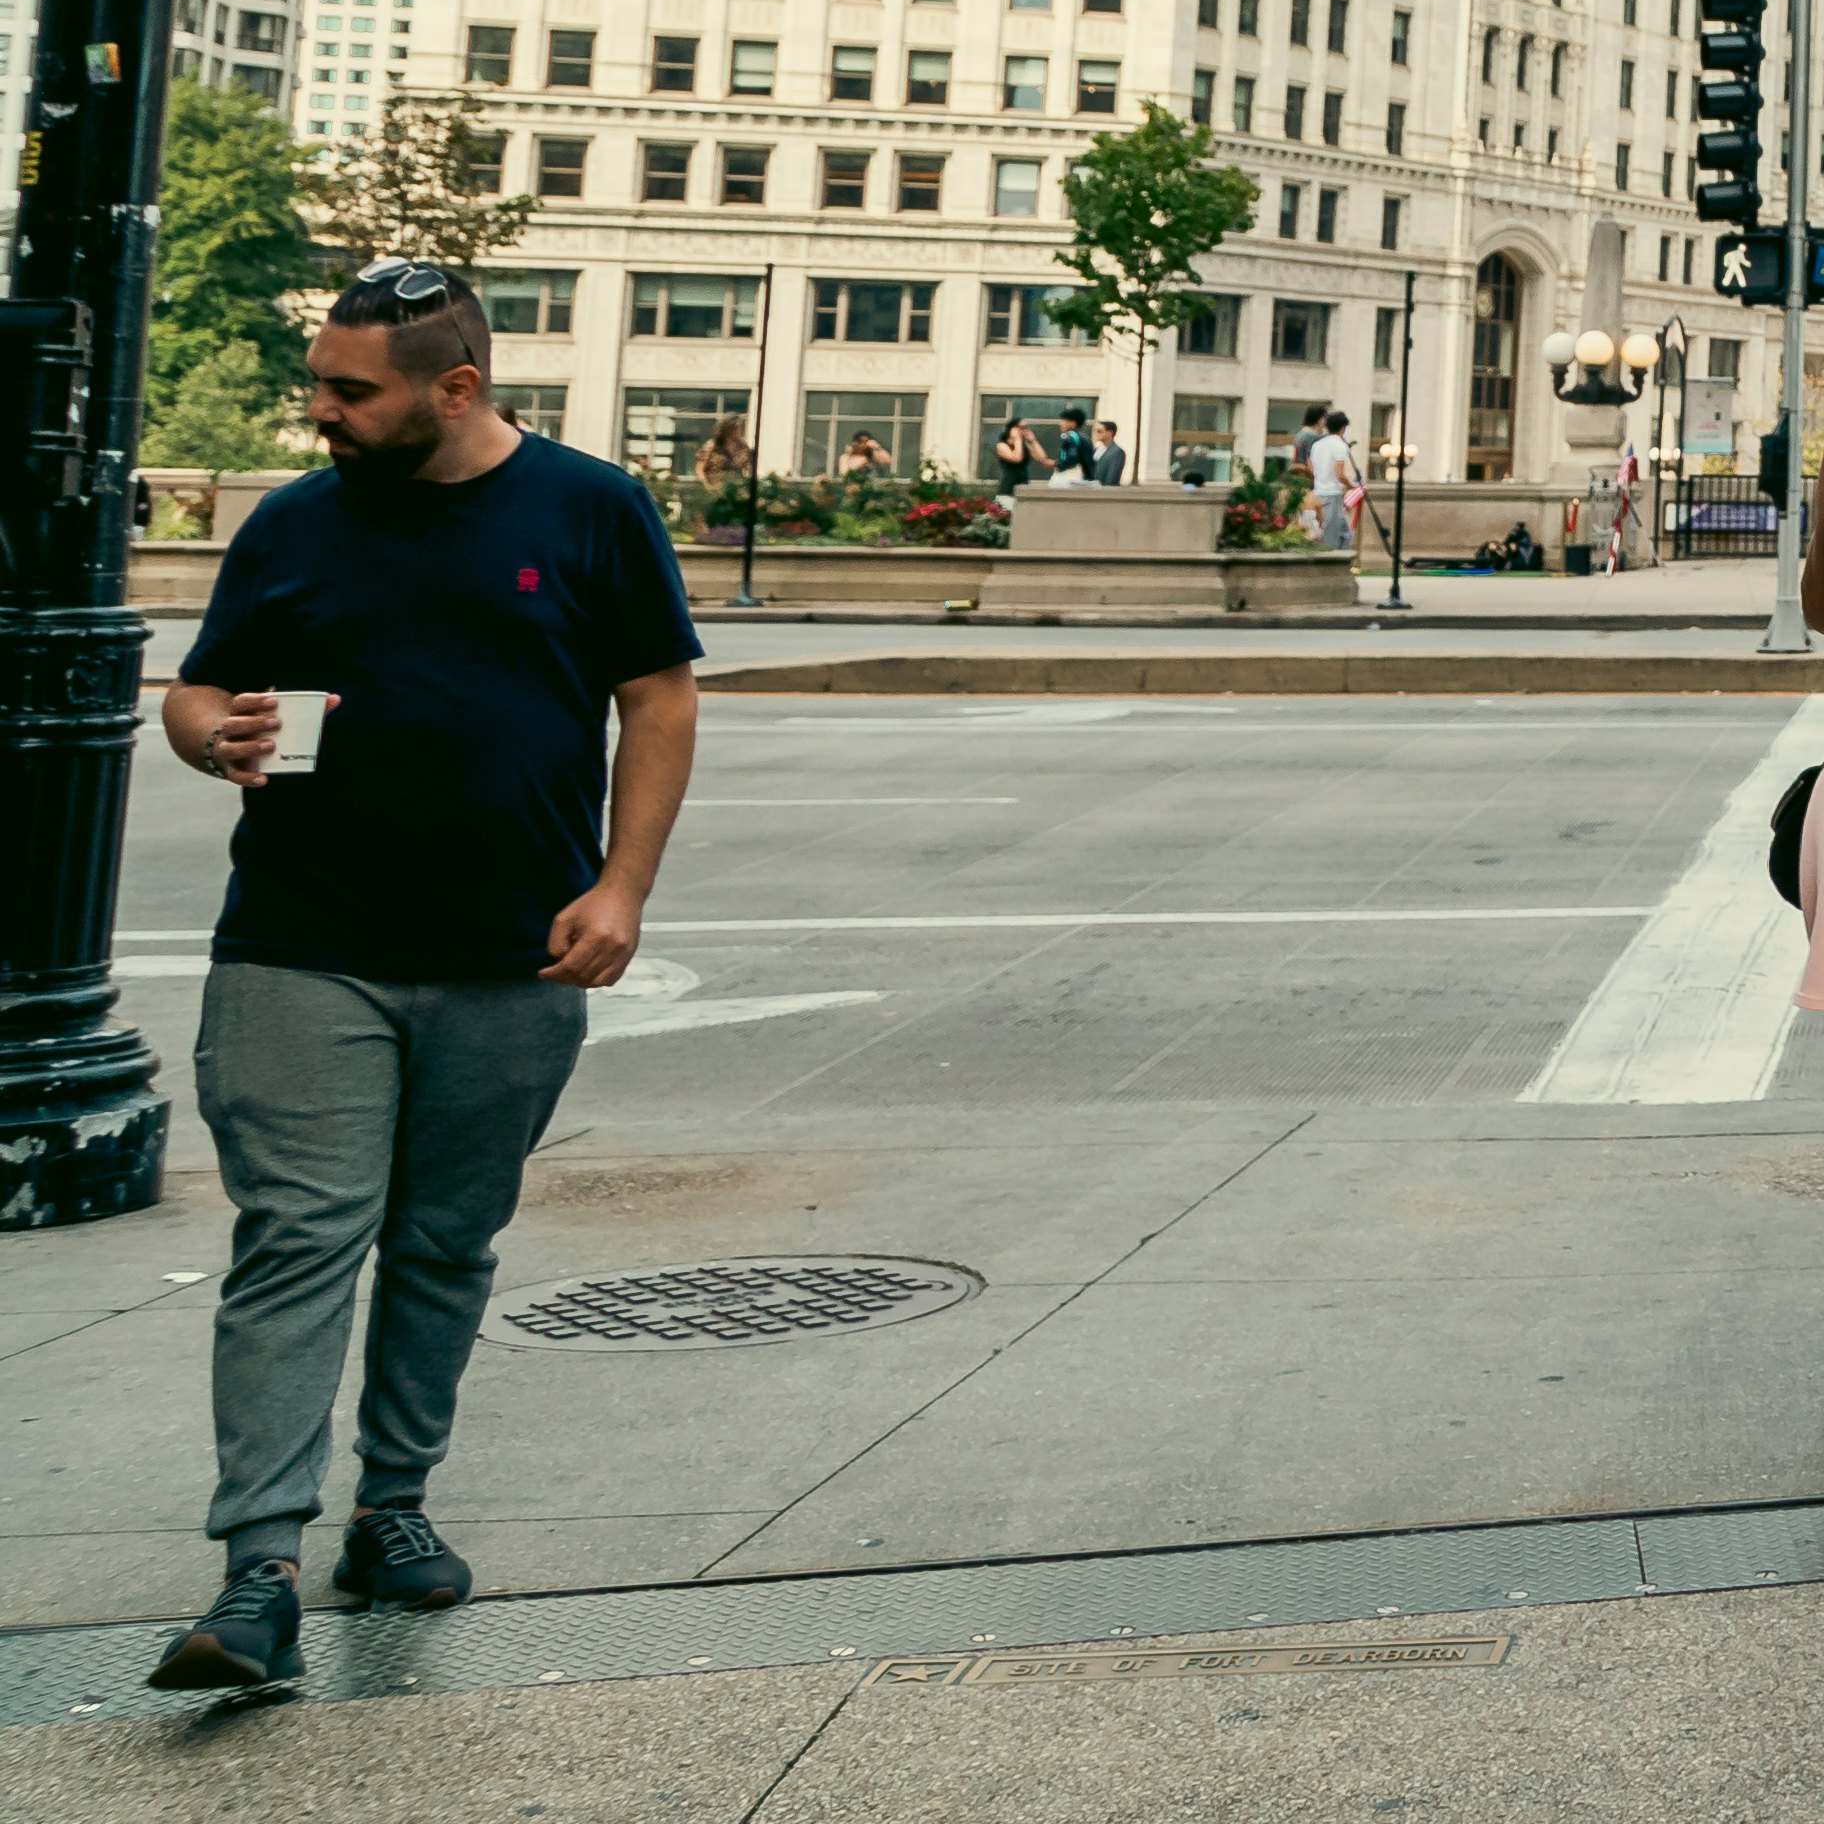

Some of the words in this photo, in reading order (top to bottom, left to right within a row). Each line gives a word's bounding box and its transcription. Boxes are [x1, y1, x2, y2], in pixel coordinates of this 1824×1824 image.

[1008, 1661, 1092, 1677] SITE
[1111, 1658, 1160, 1672] OF
[1178, 1654, 1269, 1671] FORT
[1291, 1646, 1471, 1666] DEARBORN
